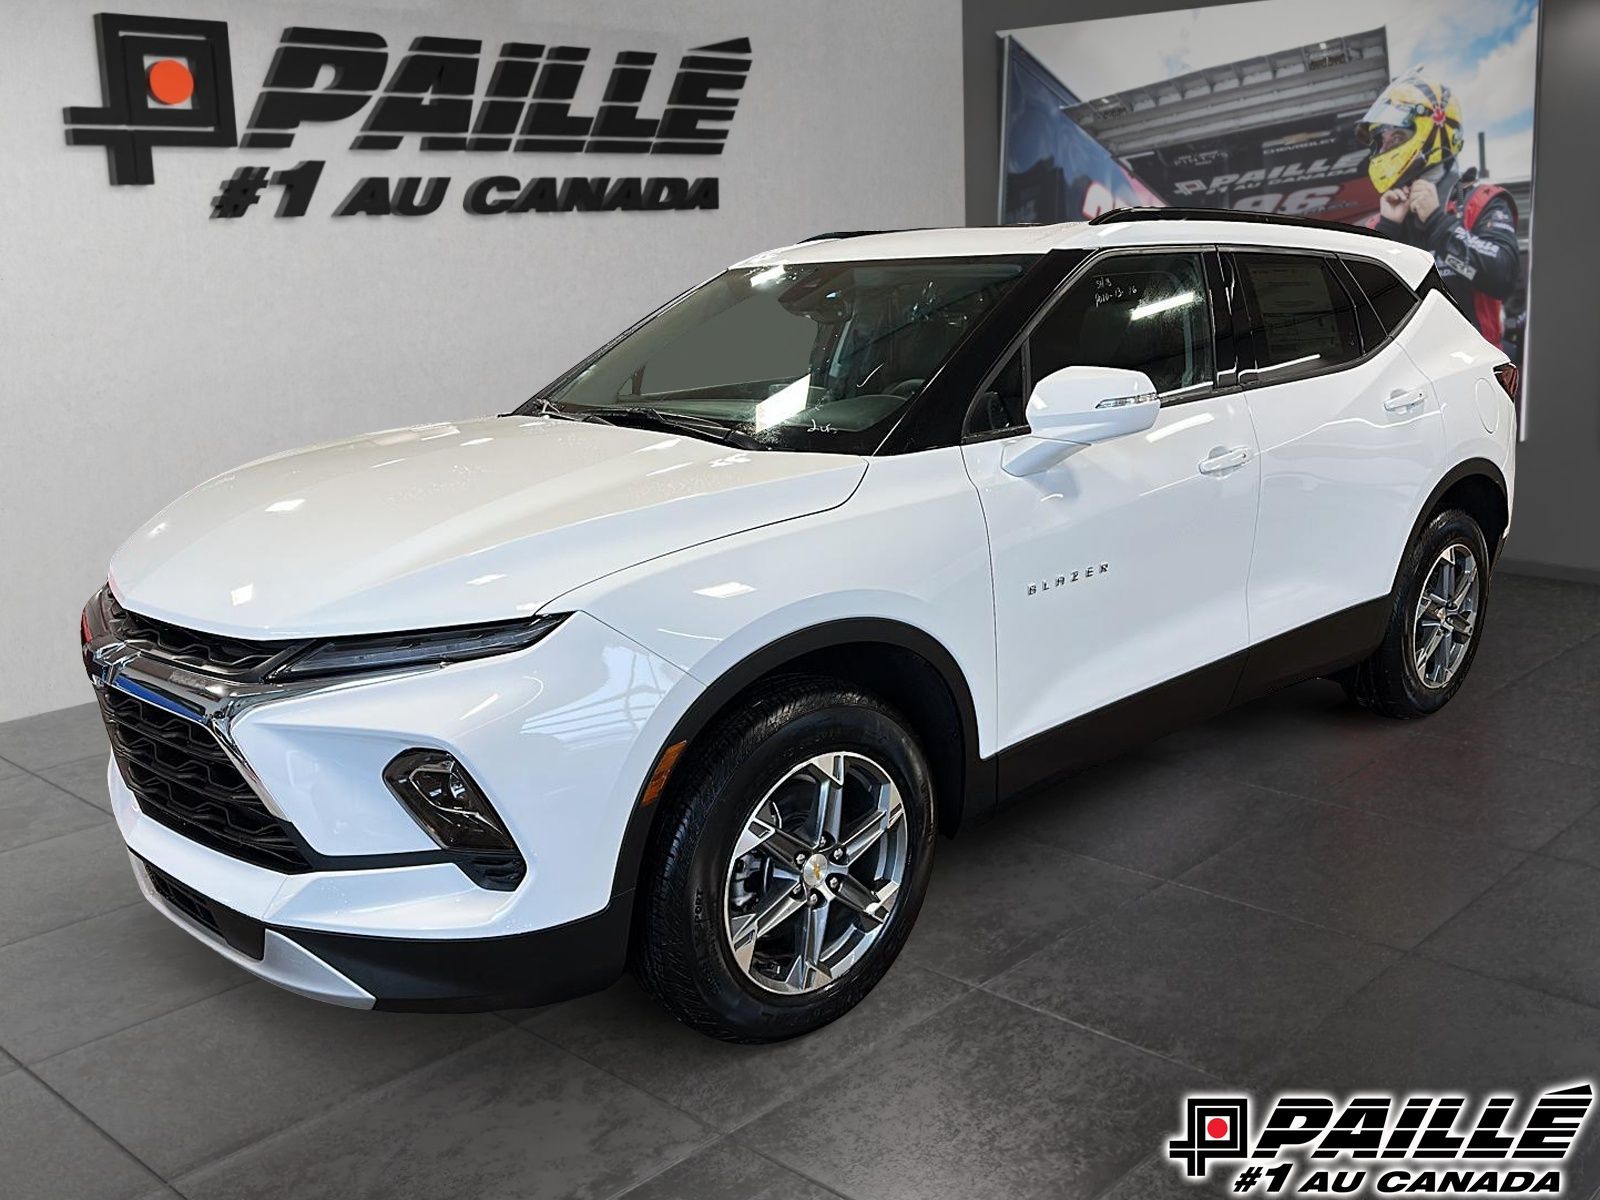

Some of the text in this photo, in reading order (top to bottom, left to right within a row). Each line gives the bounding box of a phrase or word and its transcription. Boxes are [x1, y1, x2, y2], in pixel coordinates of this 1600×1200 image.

[239, 26, 752, 155] PAILLÉ
[1263, 137, 1336, 155] CHEVROLET
[209, 160, 719, 219] #1 AU CANADA
[1268, 167, 1358, 186] CANADA
[1027, 563, 1109, 596] BLAZER
